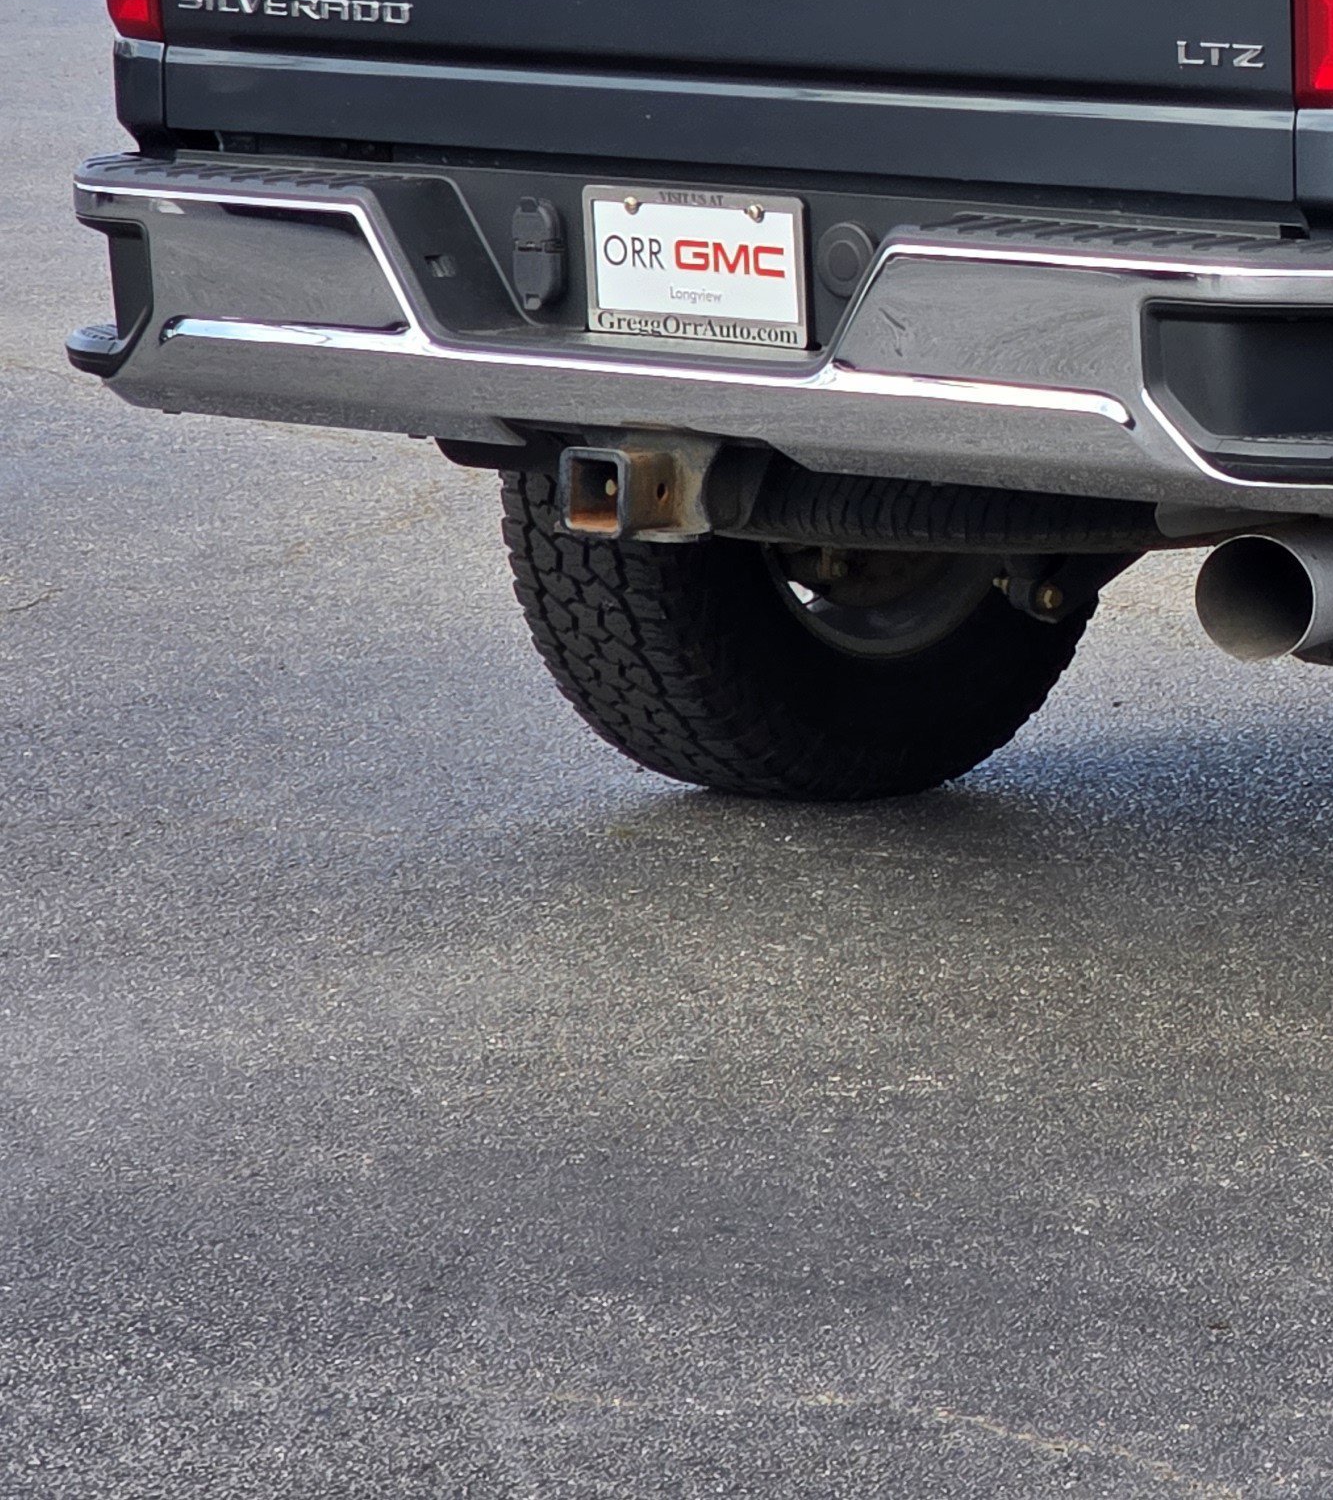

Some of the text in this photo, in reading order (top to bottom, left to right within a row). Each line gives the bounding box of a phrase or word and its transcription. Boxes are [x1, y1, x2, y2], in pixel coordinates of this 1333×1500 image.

[1176, 41, 1264, 68] LTZ
[604, 235, 785, 278] ORR GMC
[669, 286, 722, 304] Longview
[597, 310, 799, 344] GreggOrrAuto.com
